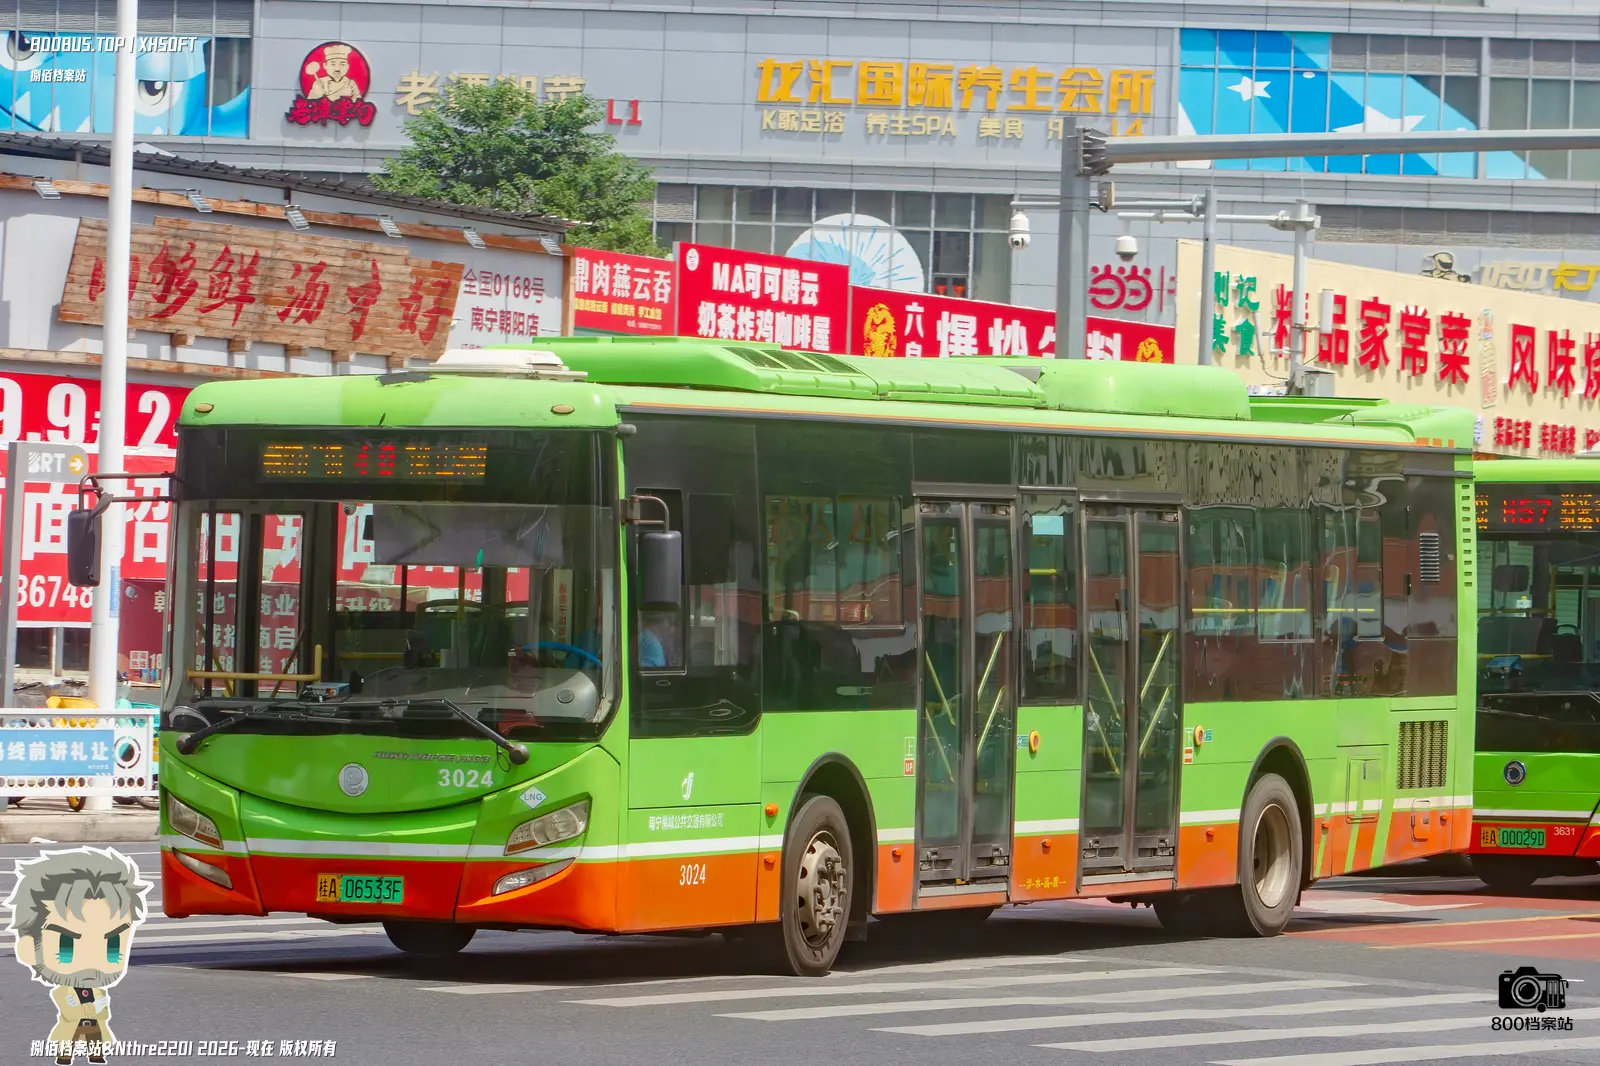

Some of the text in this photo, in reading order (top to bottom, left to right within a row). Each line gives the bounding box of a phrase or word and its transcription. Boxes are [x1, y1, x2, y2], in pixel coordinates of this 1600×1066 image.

[757, 58, 1155, 114] 龙汇国际养生会所
[607, 98, 642, 125] L1
[762, 109, 845, 133] K歌足浴
[866, 112, 956, 137] 养生SPA
[979, 117, 1023, 139] 美食
[463, 268, 545, 304] 全国0168号
[470, 306, 540, 337] 南宁朝阳店
[697, 301, 831, 352] 奶茶炸鸡咖啡屋
[28, 452, 66, 473] BRT
[0, 740, 109, 762] 线前讲礼让
[438, 768, 493, 788] 3024
[524, 793, 543, 801] LNG
[1502, 830, 1545, 846] 00029D
[1554, 826, 1575, 836] 3631
[680, 863, 706, 886] 3024
[319, 878, 402, 900] 桂A 06533F
